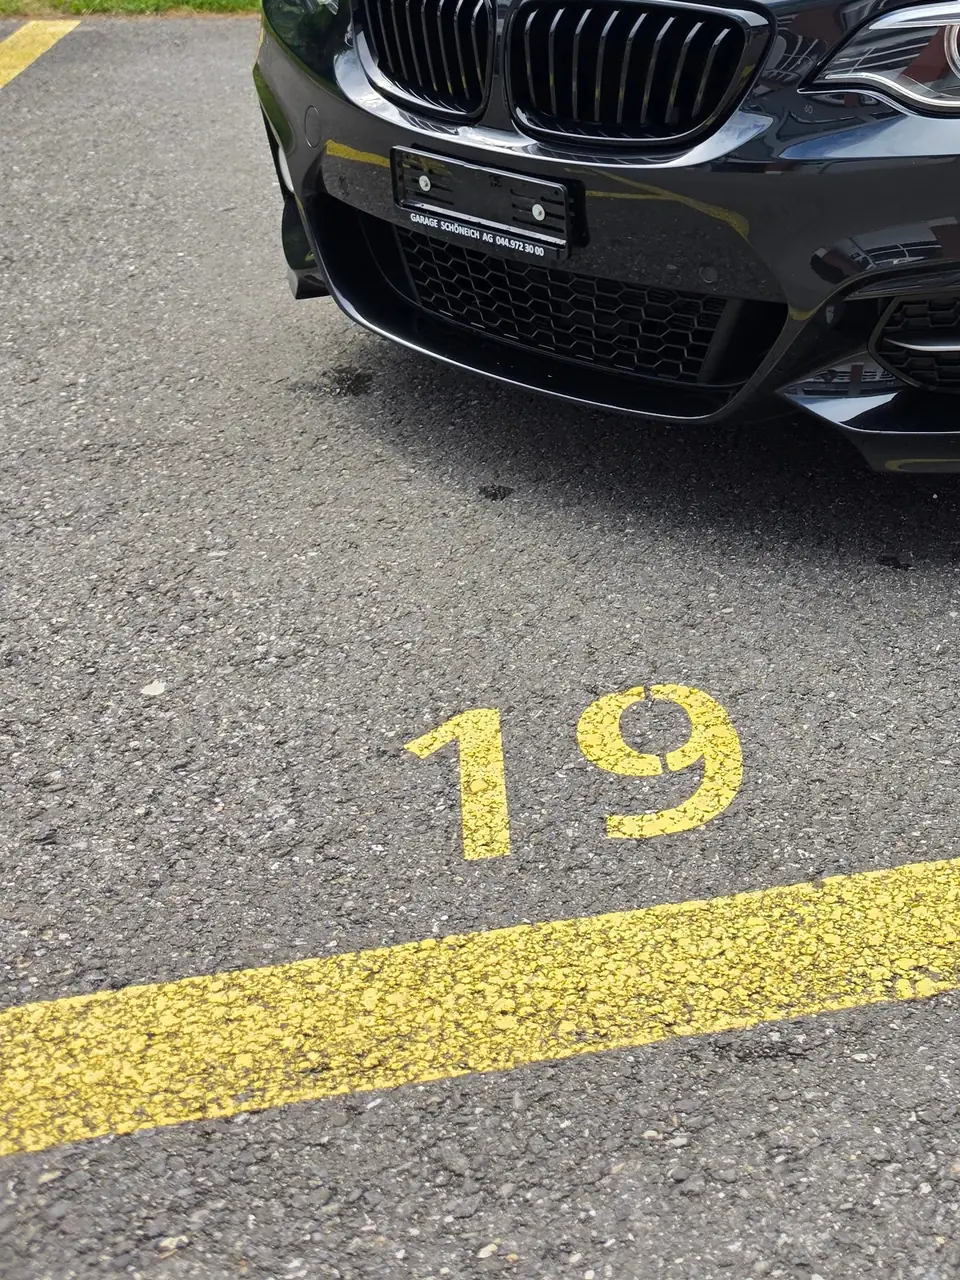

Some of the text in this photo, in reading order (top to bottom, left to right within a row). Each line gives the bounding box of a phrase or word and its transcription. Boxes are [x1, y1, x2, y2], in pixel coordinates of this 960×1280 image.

[410, 212, 545, 257] GARAGE SCHÖNEICH AG 044.972 30 00
[404, 683, 743, 860] 19
